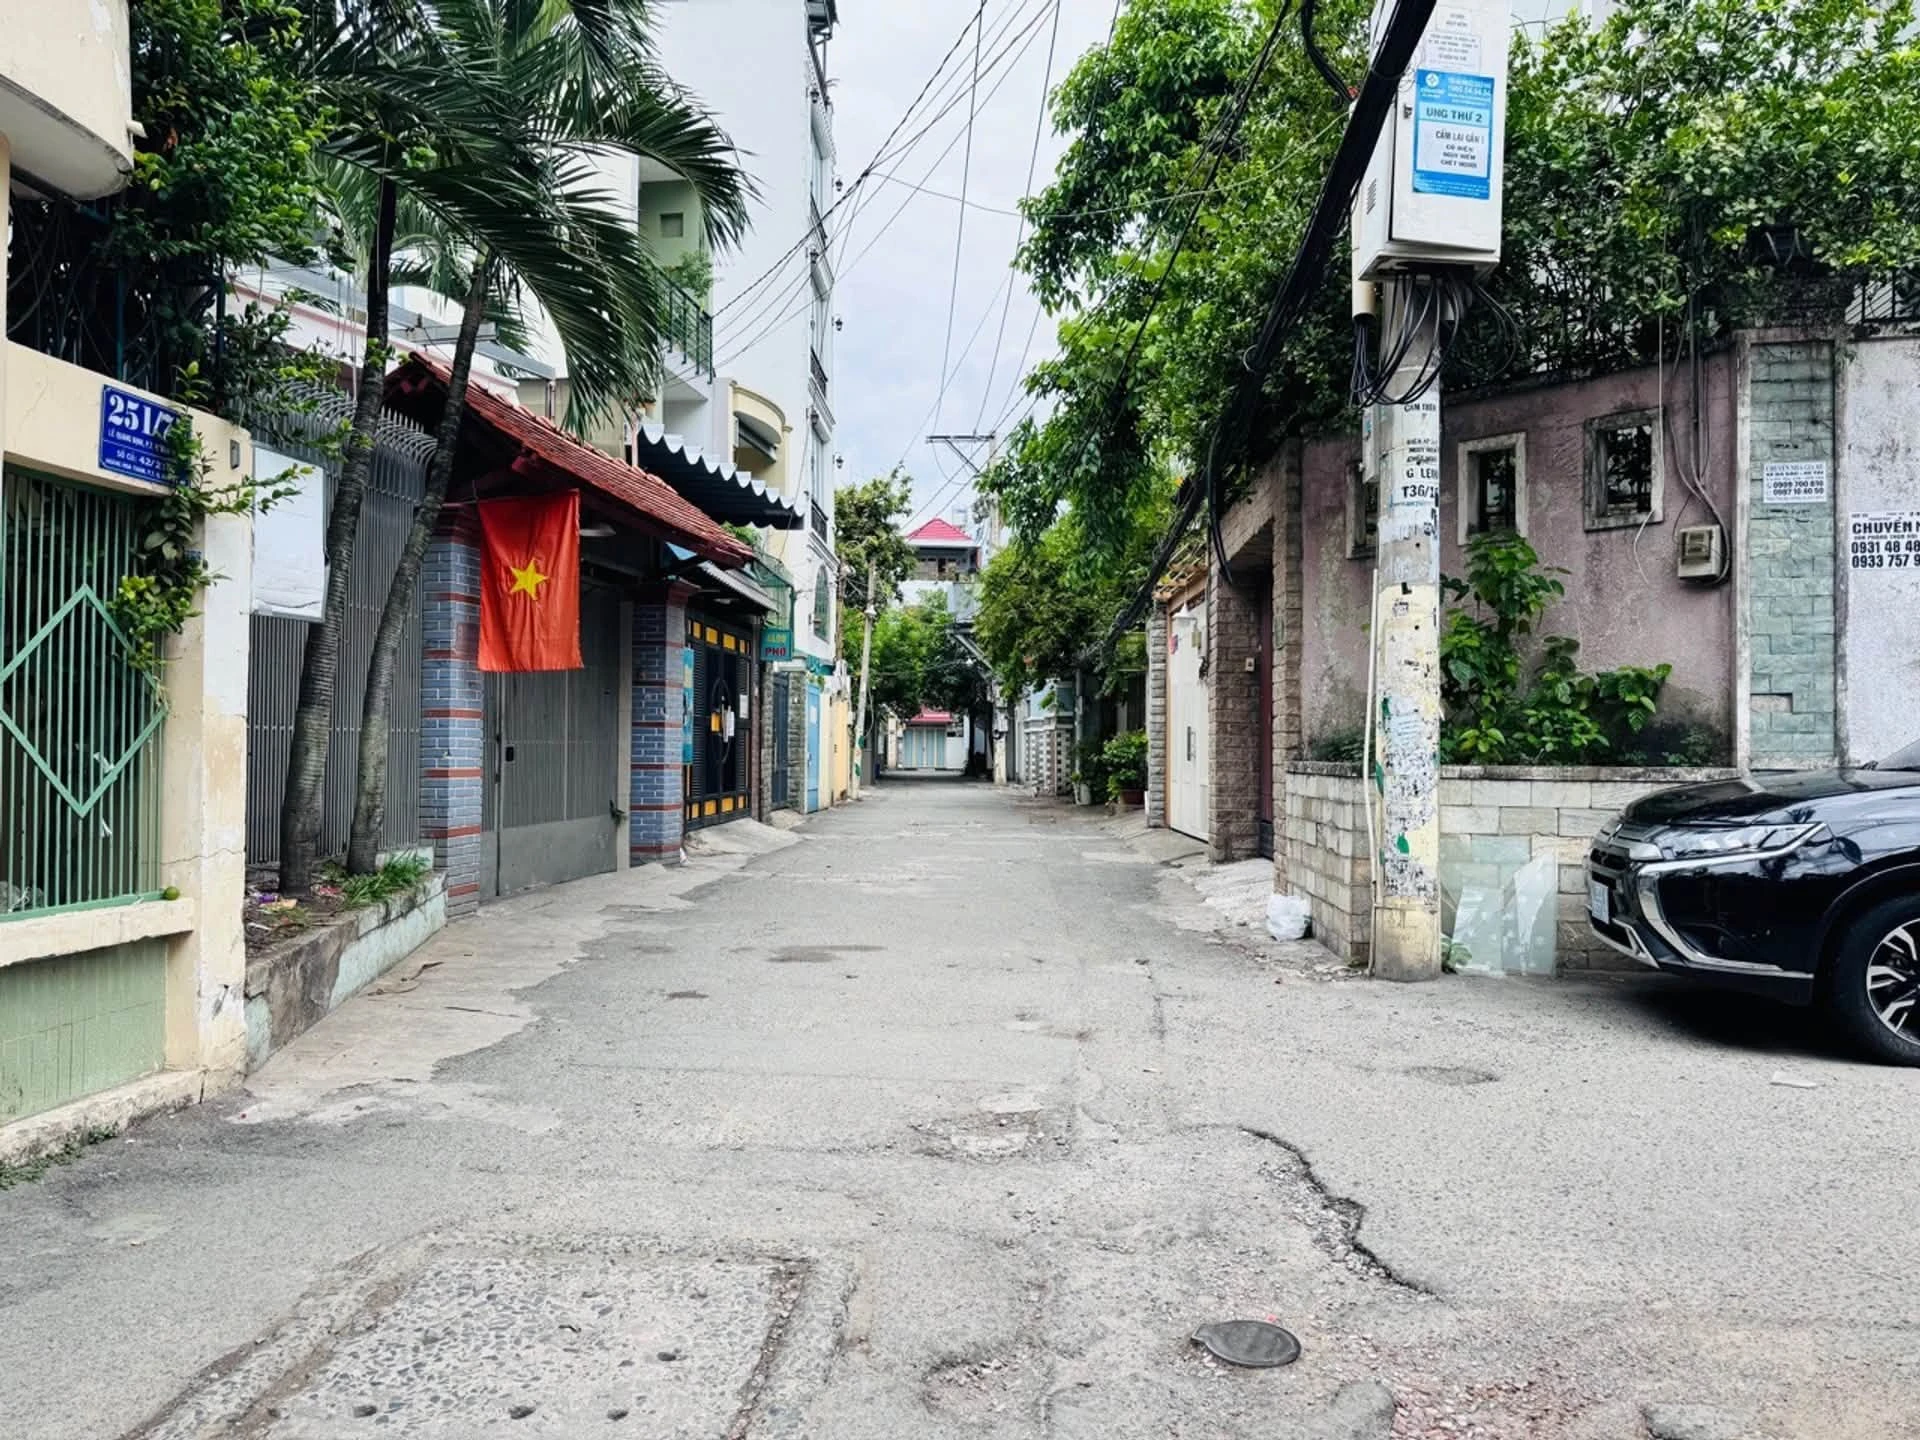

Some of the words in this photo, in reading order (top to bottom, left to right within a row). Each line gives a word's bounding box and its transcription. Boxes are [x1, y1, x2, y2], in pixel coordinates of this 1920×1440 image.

[1426, 107, 1448, 118] UNG
[1451, 110, 1473, 121] THƯ
[1475, 114, 1482, 123] 2
[1852, 517, 1912, 534] CHUYỂN
[1851, 541, 1880, 554] 0931
[1884, 540, 1900, 553] 48
[1852, 554, 1884, 568] 0933
[1887, 553, 1909, 567] 757
